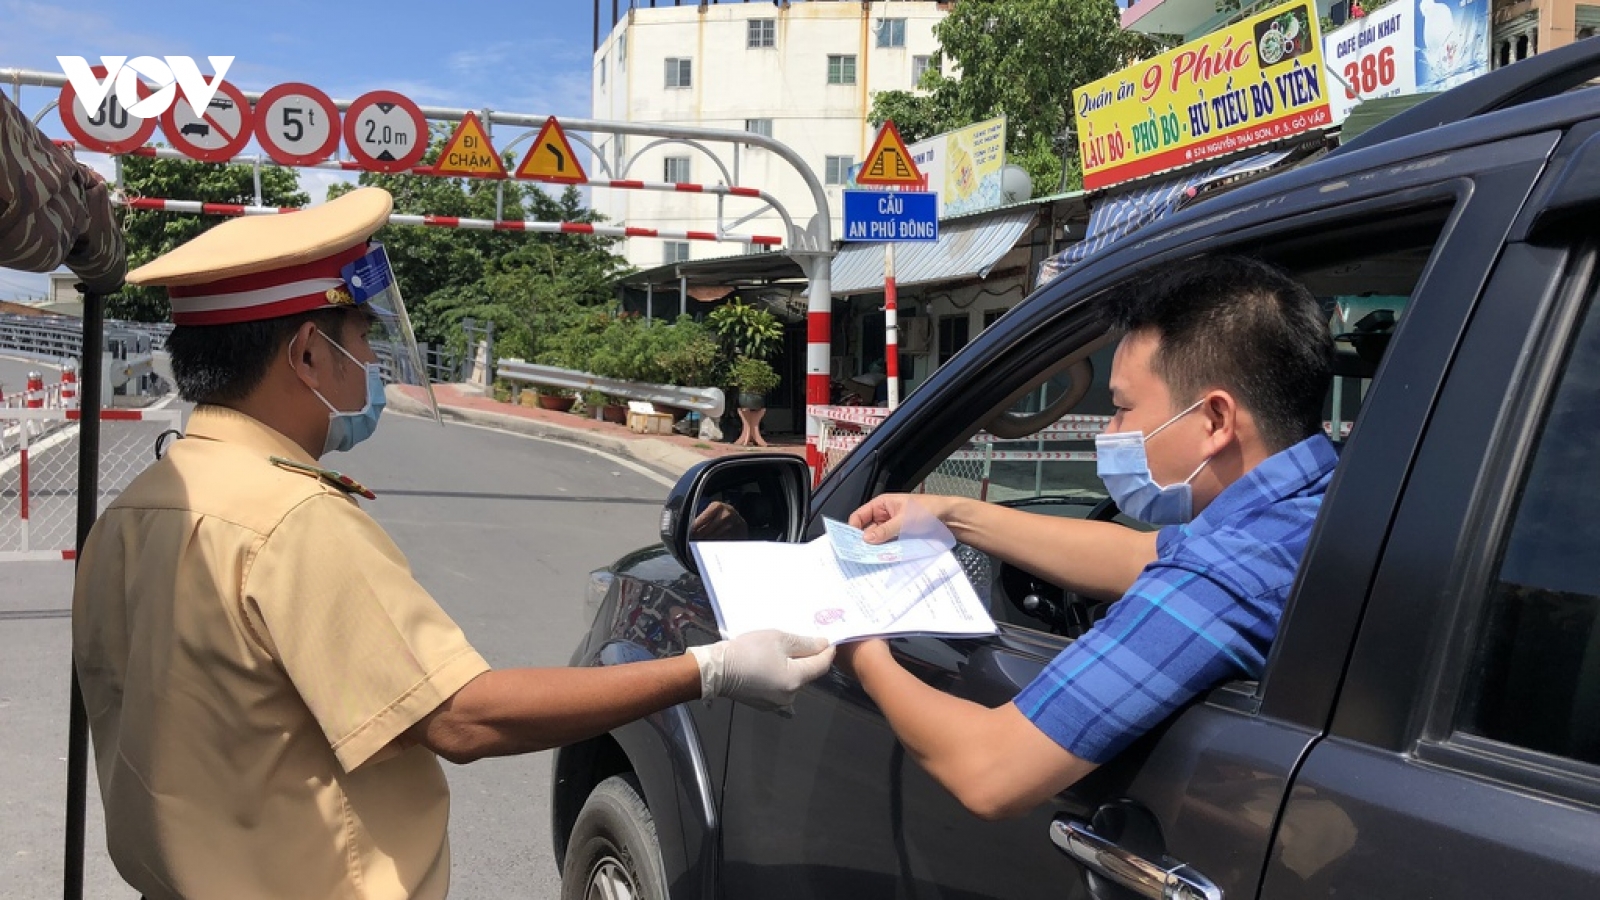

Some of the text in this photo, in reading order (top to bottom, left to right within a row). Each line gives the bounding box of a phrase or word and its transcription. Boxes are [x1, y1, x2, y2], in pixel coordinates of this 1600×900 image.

[1378, 14, 1401, 39] KHÁT
[1078, 36, 1252, 117] Quán ăn 9 Phúc
[1344, 45, 1395, 100] 386
[1081, 122, 1105, 169] LẨU
[1107, 123, 1124, 161] BÒ
[1160, 103, 1179, 145] BÒ
[1188, 89, 1210, 137] HỦ
[1212, 77, 1248, 129] TIẾU
[1250, 72, 1274, 118] BÒ
[1275, 59, 1320, 109] VIÊN
[1292, 117, 1307, 129] GÒ
[1308, 109, 1326, 124] VẤP
[463, 135, 478, 148] ĐI
[849, 219, 934, 238] AN PHÚ ĐÔNG
